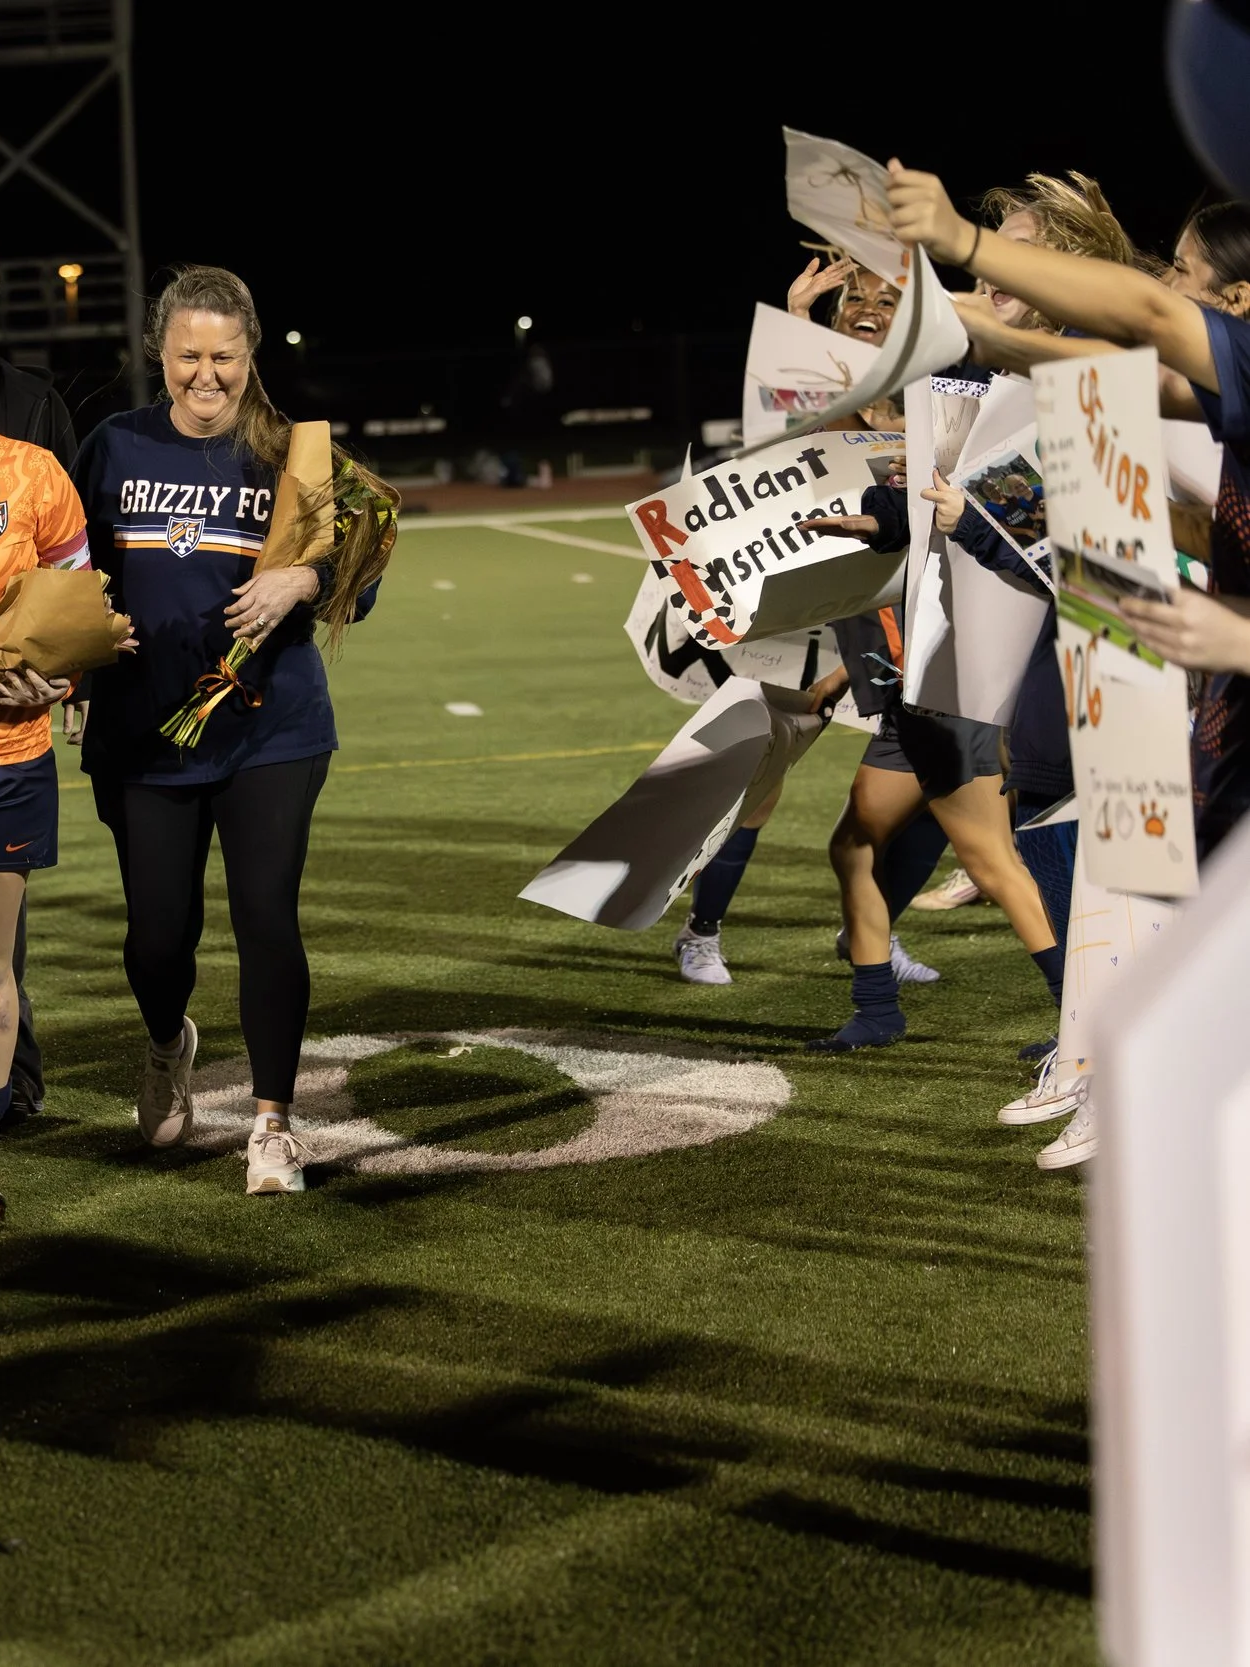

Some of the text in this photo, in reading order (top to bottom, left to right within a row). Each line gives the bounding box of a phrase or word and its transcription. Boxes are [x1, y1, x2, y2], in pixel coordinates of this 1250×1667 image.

[120, 480, 271, 521] GRIZZLY FC
[635, 447, 829, 559] Radiant
